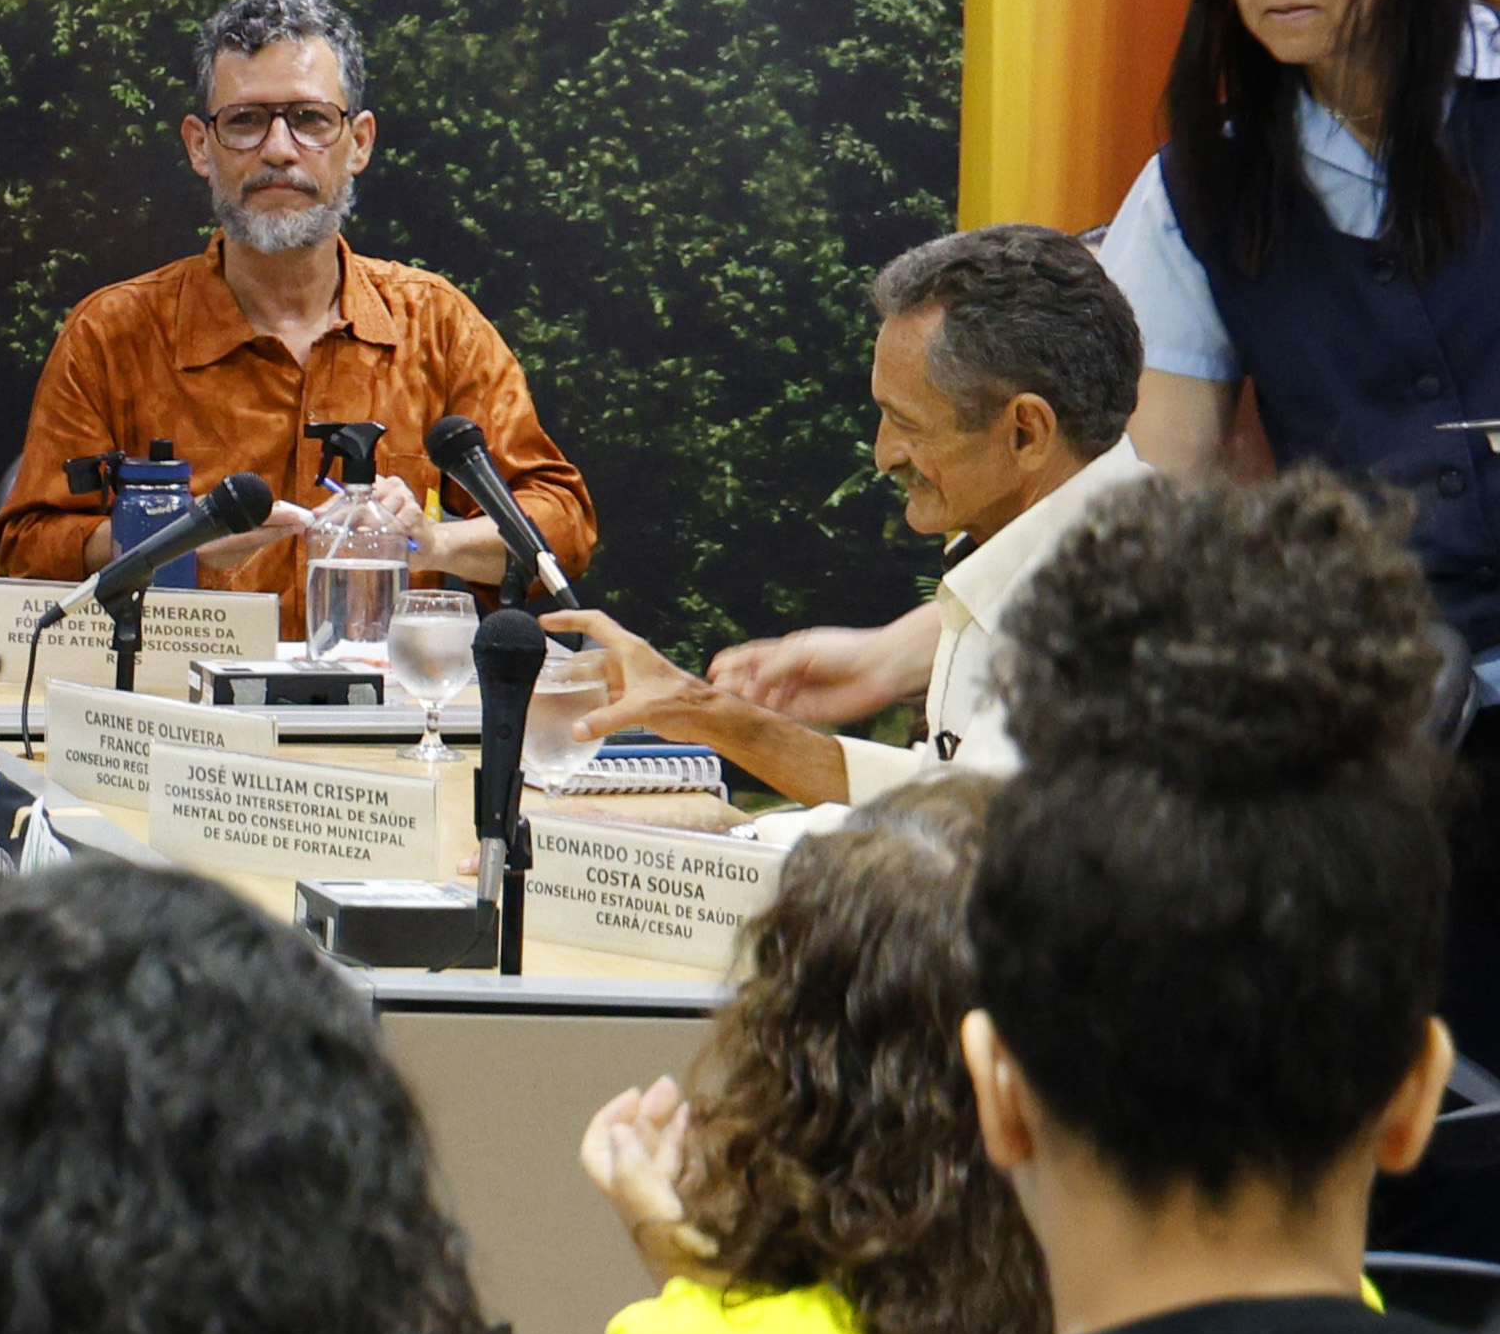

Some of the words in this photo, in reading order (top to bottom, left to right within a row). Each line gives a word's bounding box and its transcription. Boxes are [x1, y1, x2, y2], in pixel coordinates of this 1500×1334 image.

[67, 619, 86, 632] DE
[90, 621, 211, 640] TRAHADORES
[215, 628, 235, 639] DA
[142, 605, 227, 622] EMERARO
[7, 632, 44, 644] REDE
[47, 635, 66, 646] DE
[142, 641, 243, 656] PSICOSSOCIAL
[84, 709, 134, 732] CARINE
[137, 719, 155, 736] DE
[158, 722, 226, 748] OLIVEIRA
[99, 734, 150, 757] FRANCO
[65, 749, 121, 771] CONSELHO
[96, 772, 135, 792] SOCIAL
[187, 764, 227, 786] JOSÉ
[232, 769, 308, 797] WILLIAM
[313, 782, 389, 806] CRISPIM
[164, 783, 232, 805] COMISSÃO
[235, 794, 342, 820] INTERSETORIAL
[346, 807, 364, 822] DE
[369, 807, 416, 829] SAÚDE
[172, 803, 225, 823] MENTAL
[228, 810, 247, 825] DO
[250, 813, 323, 836] CONSELHO
[327, 823, 406, 848] MUNICIPAL
[203, 825, 221, 840] DE
[224, 827, 268, 847] SAÚDE
[272, 834, 290, 850] DE
[294, 838, 372, 862] FORTALEZA
[536, 833, 628, 864] LEONARDO
[633, 848, 676, 871] JOSÉ
[681, 856, 759, 885] APRÍGIO
[586, 866, 642, 891] COSTA
[646, 876, 706, 902] SOUSA
[526, 879, 597, 904] CONSELHO
[601, 892, 672, 917] ESTADUAL
[675, 903, 693, 919] DE
[697, 906, 744, 928] SAÚDE
[596, 910, 693, 940] CEARÁ/CESAU
